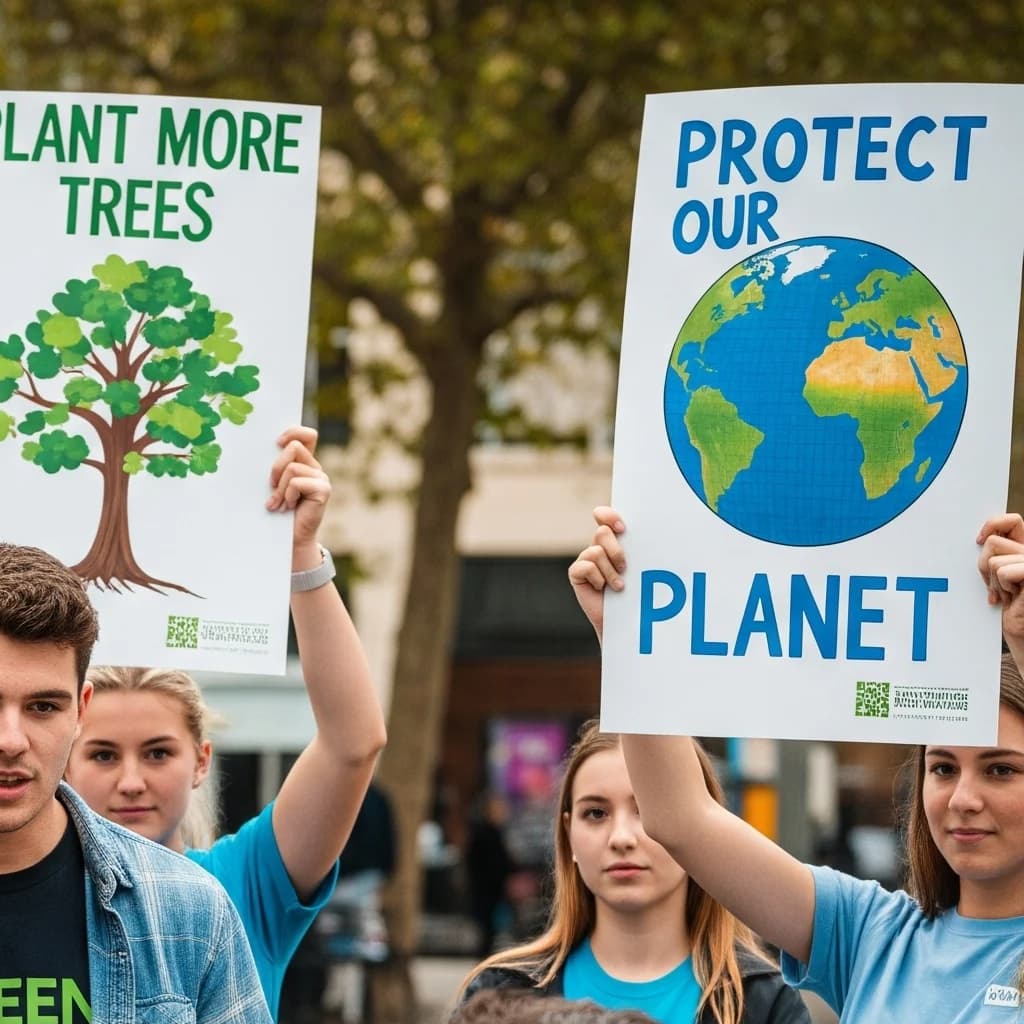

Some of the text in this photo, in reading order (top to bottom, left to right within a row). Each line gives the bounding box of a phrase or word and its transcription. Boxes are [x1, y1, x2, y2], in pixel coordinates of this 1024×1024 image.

[157, 107, 303, 174] MORE
[676, 115, 987, 188] PROTECT
[59, 176, 215, 242] TREES
[672, 191, 779, 254] OUR
[639, 569, 949, 662] PLANET
